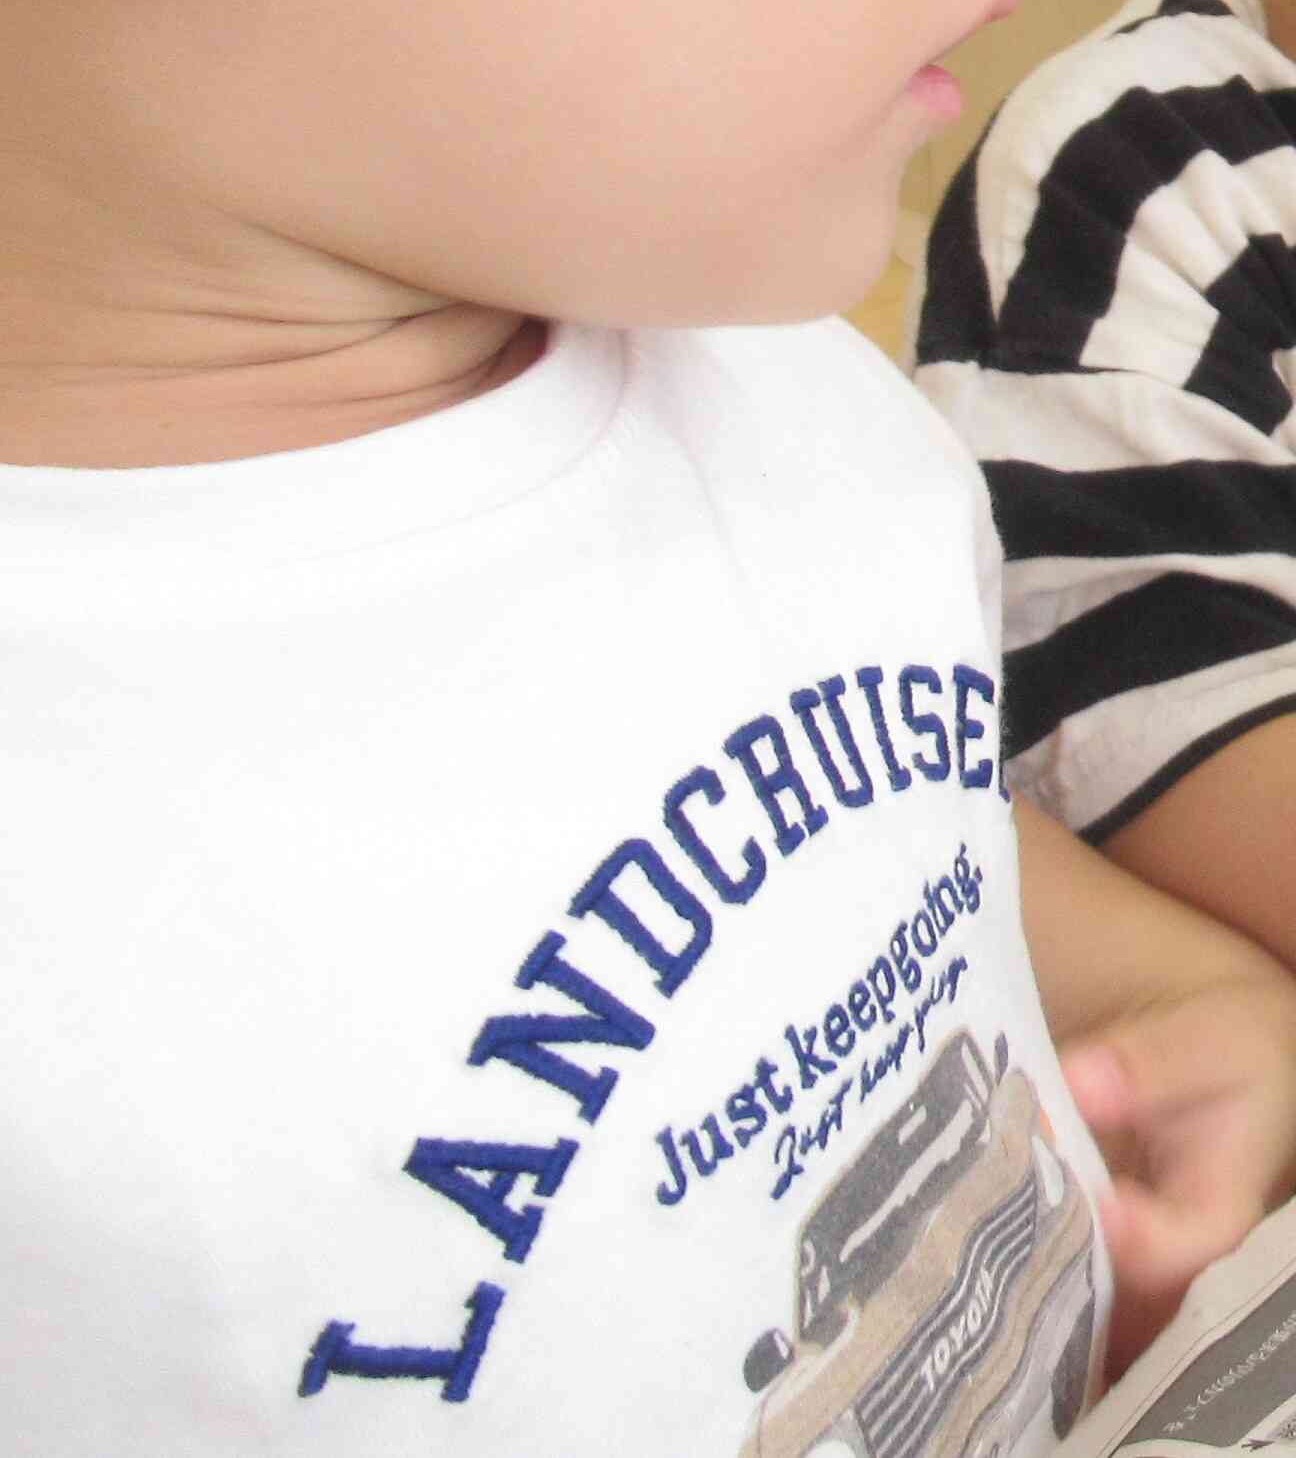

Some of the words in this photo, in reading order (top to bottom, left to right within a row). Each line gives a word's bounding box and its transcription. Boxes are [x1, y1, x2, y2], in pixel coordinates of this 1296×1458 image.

[298, 661, 1012, 1402] LANDCRUISE
[655, 1057, 793, 1205] Just
[921, 1265, 995, 1392] TOYOTA
